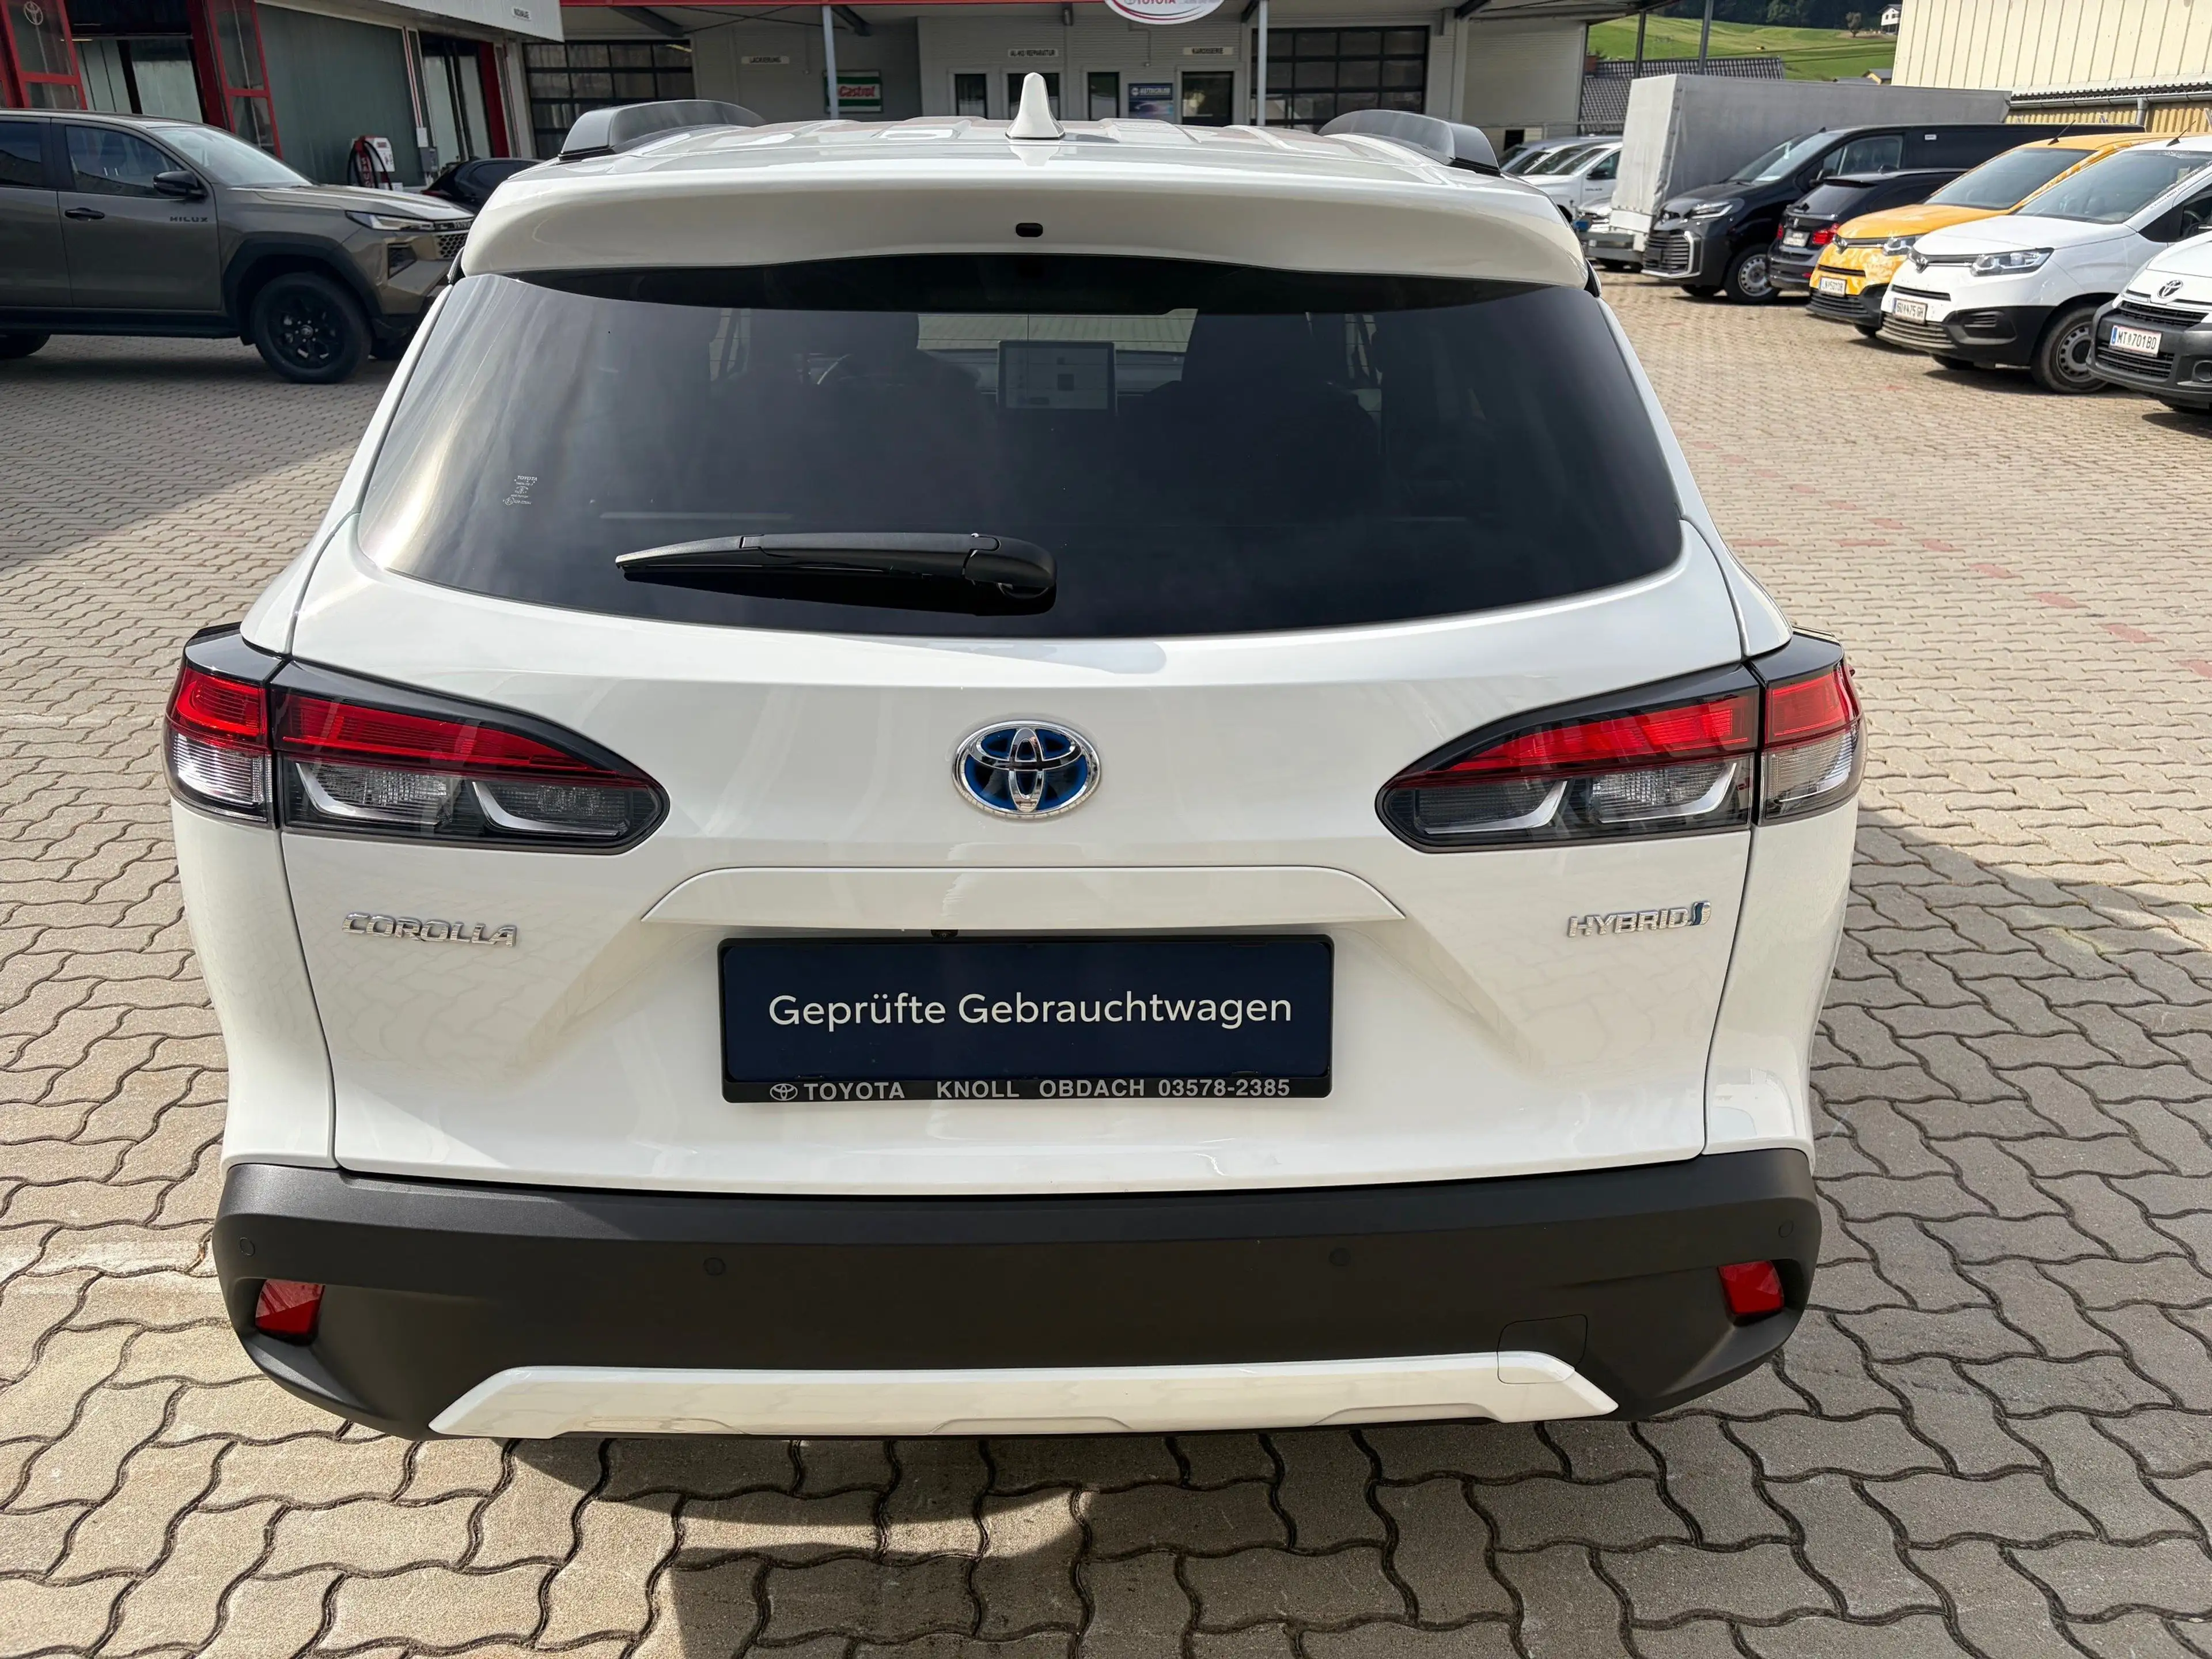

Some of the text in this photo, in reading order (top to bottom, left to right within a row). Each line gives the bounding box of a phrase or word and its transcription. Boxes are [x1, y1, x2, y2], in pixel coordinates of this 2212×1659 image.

[839, 85, 875, 97] Castrol
[342, 912, 517, 947] COROLLA
[1567, 907, 1690, 937] HYBRID
[769, 990, 1291, 1032] Geprüfte Gebrauchtwagen
[804, 1079, 1290, 1100] TOYOTA KNOLL OBDACH 03578-2385
